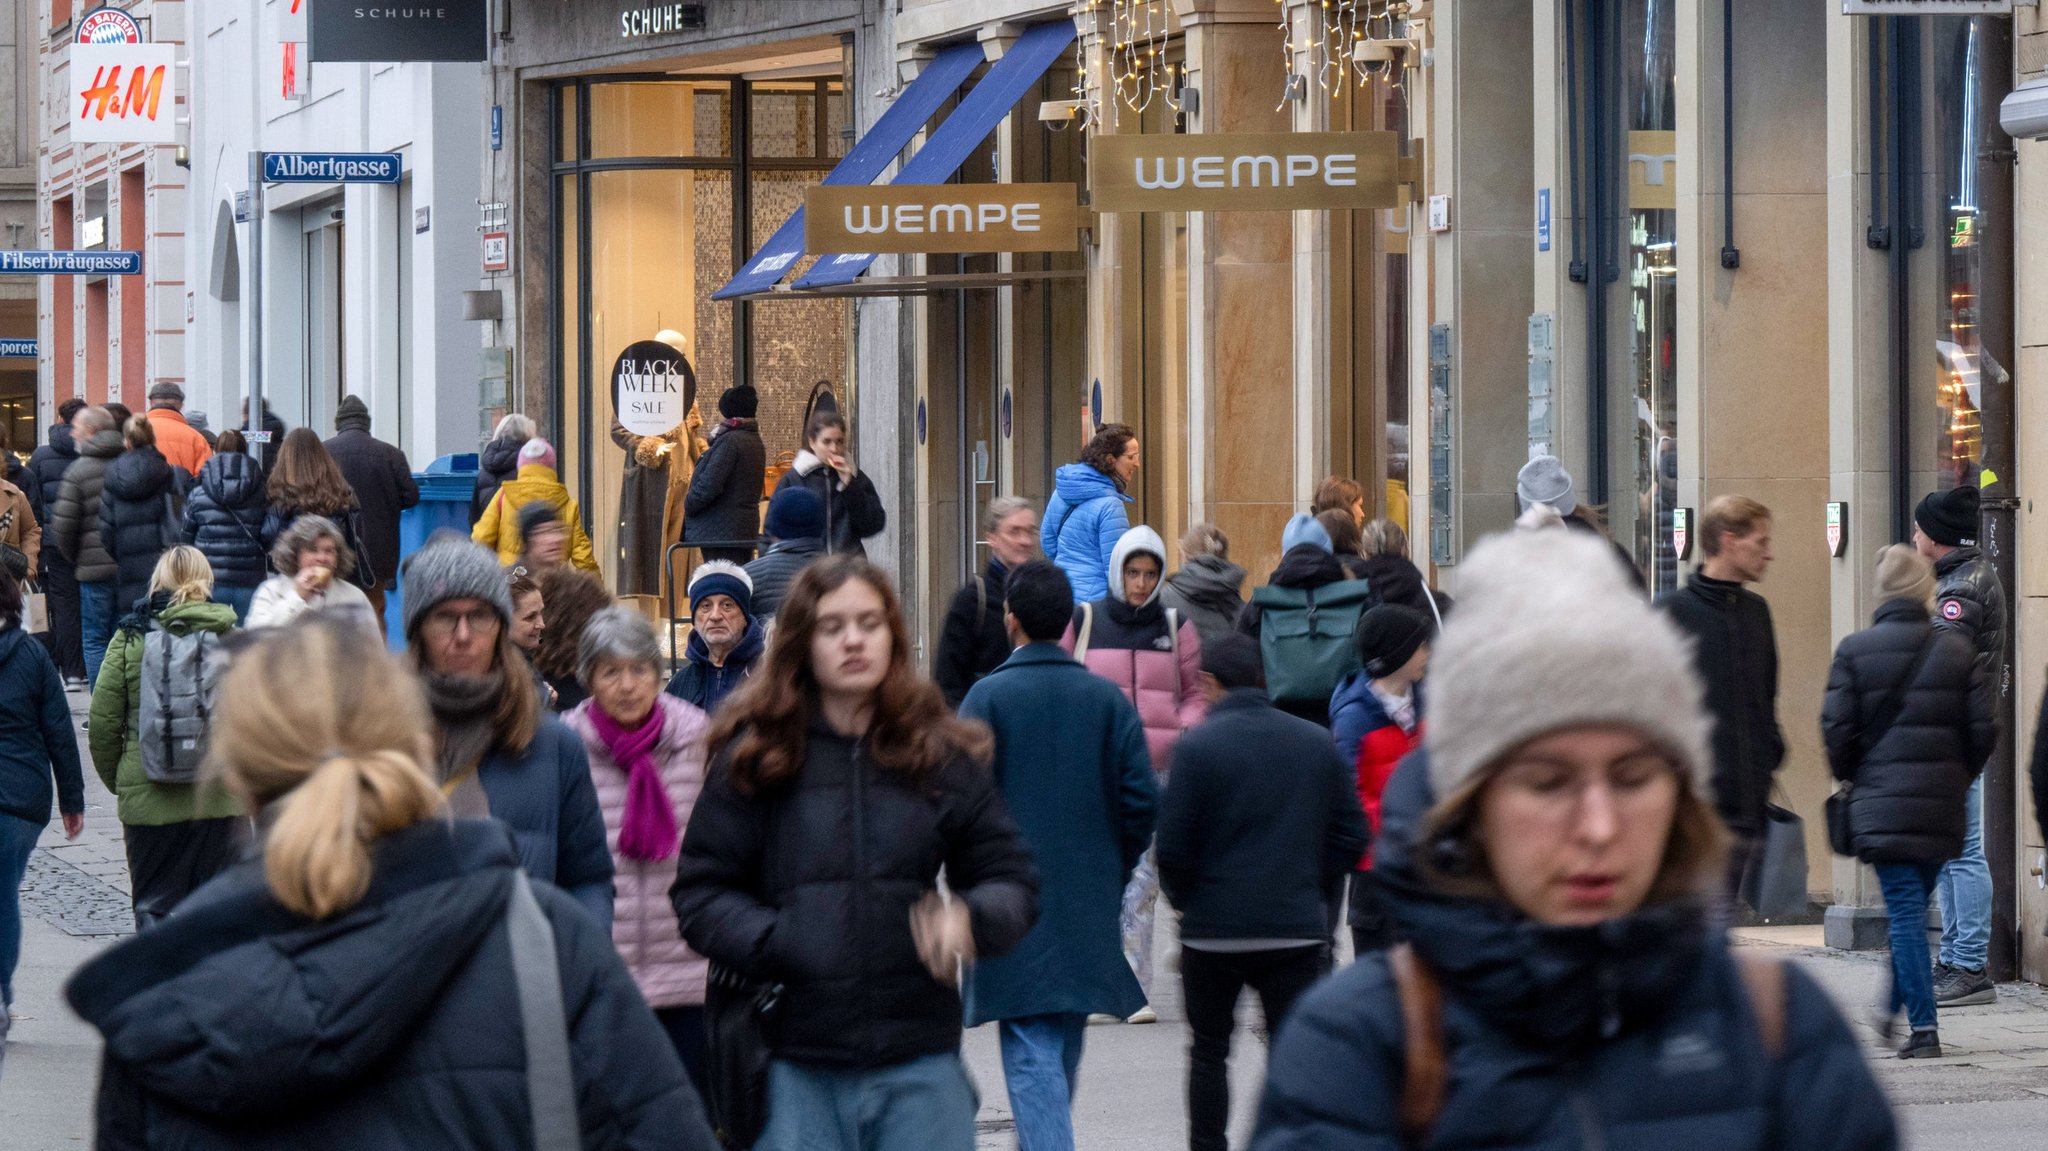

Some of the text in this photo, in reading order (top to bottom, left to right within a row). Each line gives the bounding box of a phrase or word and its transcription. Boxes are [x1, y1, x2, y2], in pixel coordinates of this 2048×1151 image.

[82, 13, 135, 37] FC BAYERN
[354, 8, 446, 19] SCHUHE
[622, 4, 682, 37] SCHUHE
[80, 64, 165, 121] H&M
[274, 155, 390, 180] Albertgasse
[1135, 154, 1356, 189] WEMPE
[844, 203, 1041, 234] WEMPE
[2, 252, 131, 272] Filserbräugasse
[622, 359, 679, 376] BLACK
[623, 374, 677, 393] WEEK
[631, 401, 666, 414] SALE
